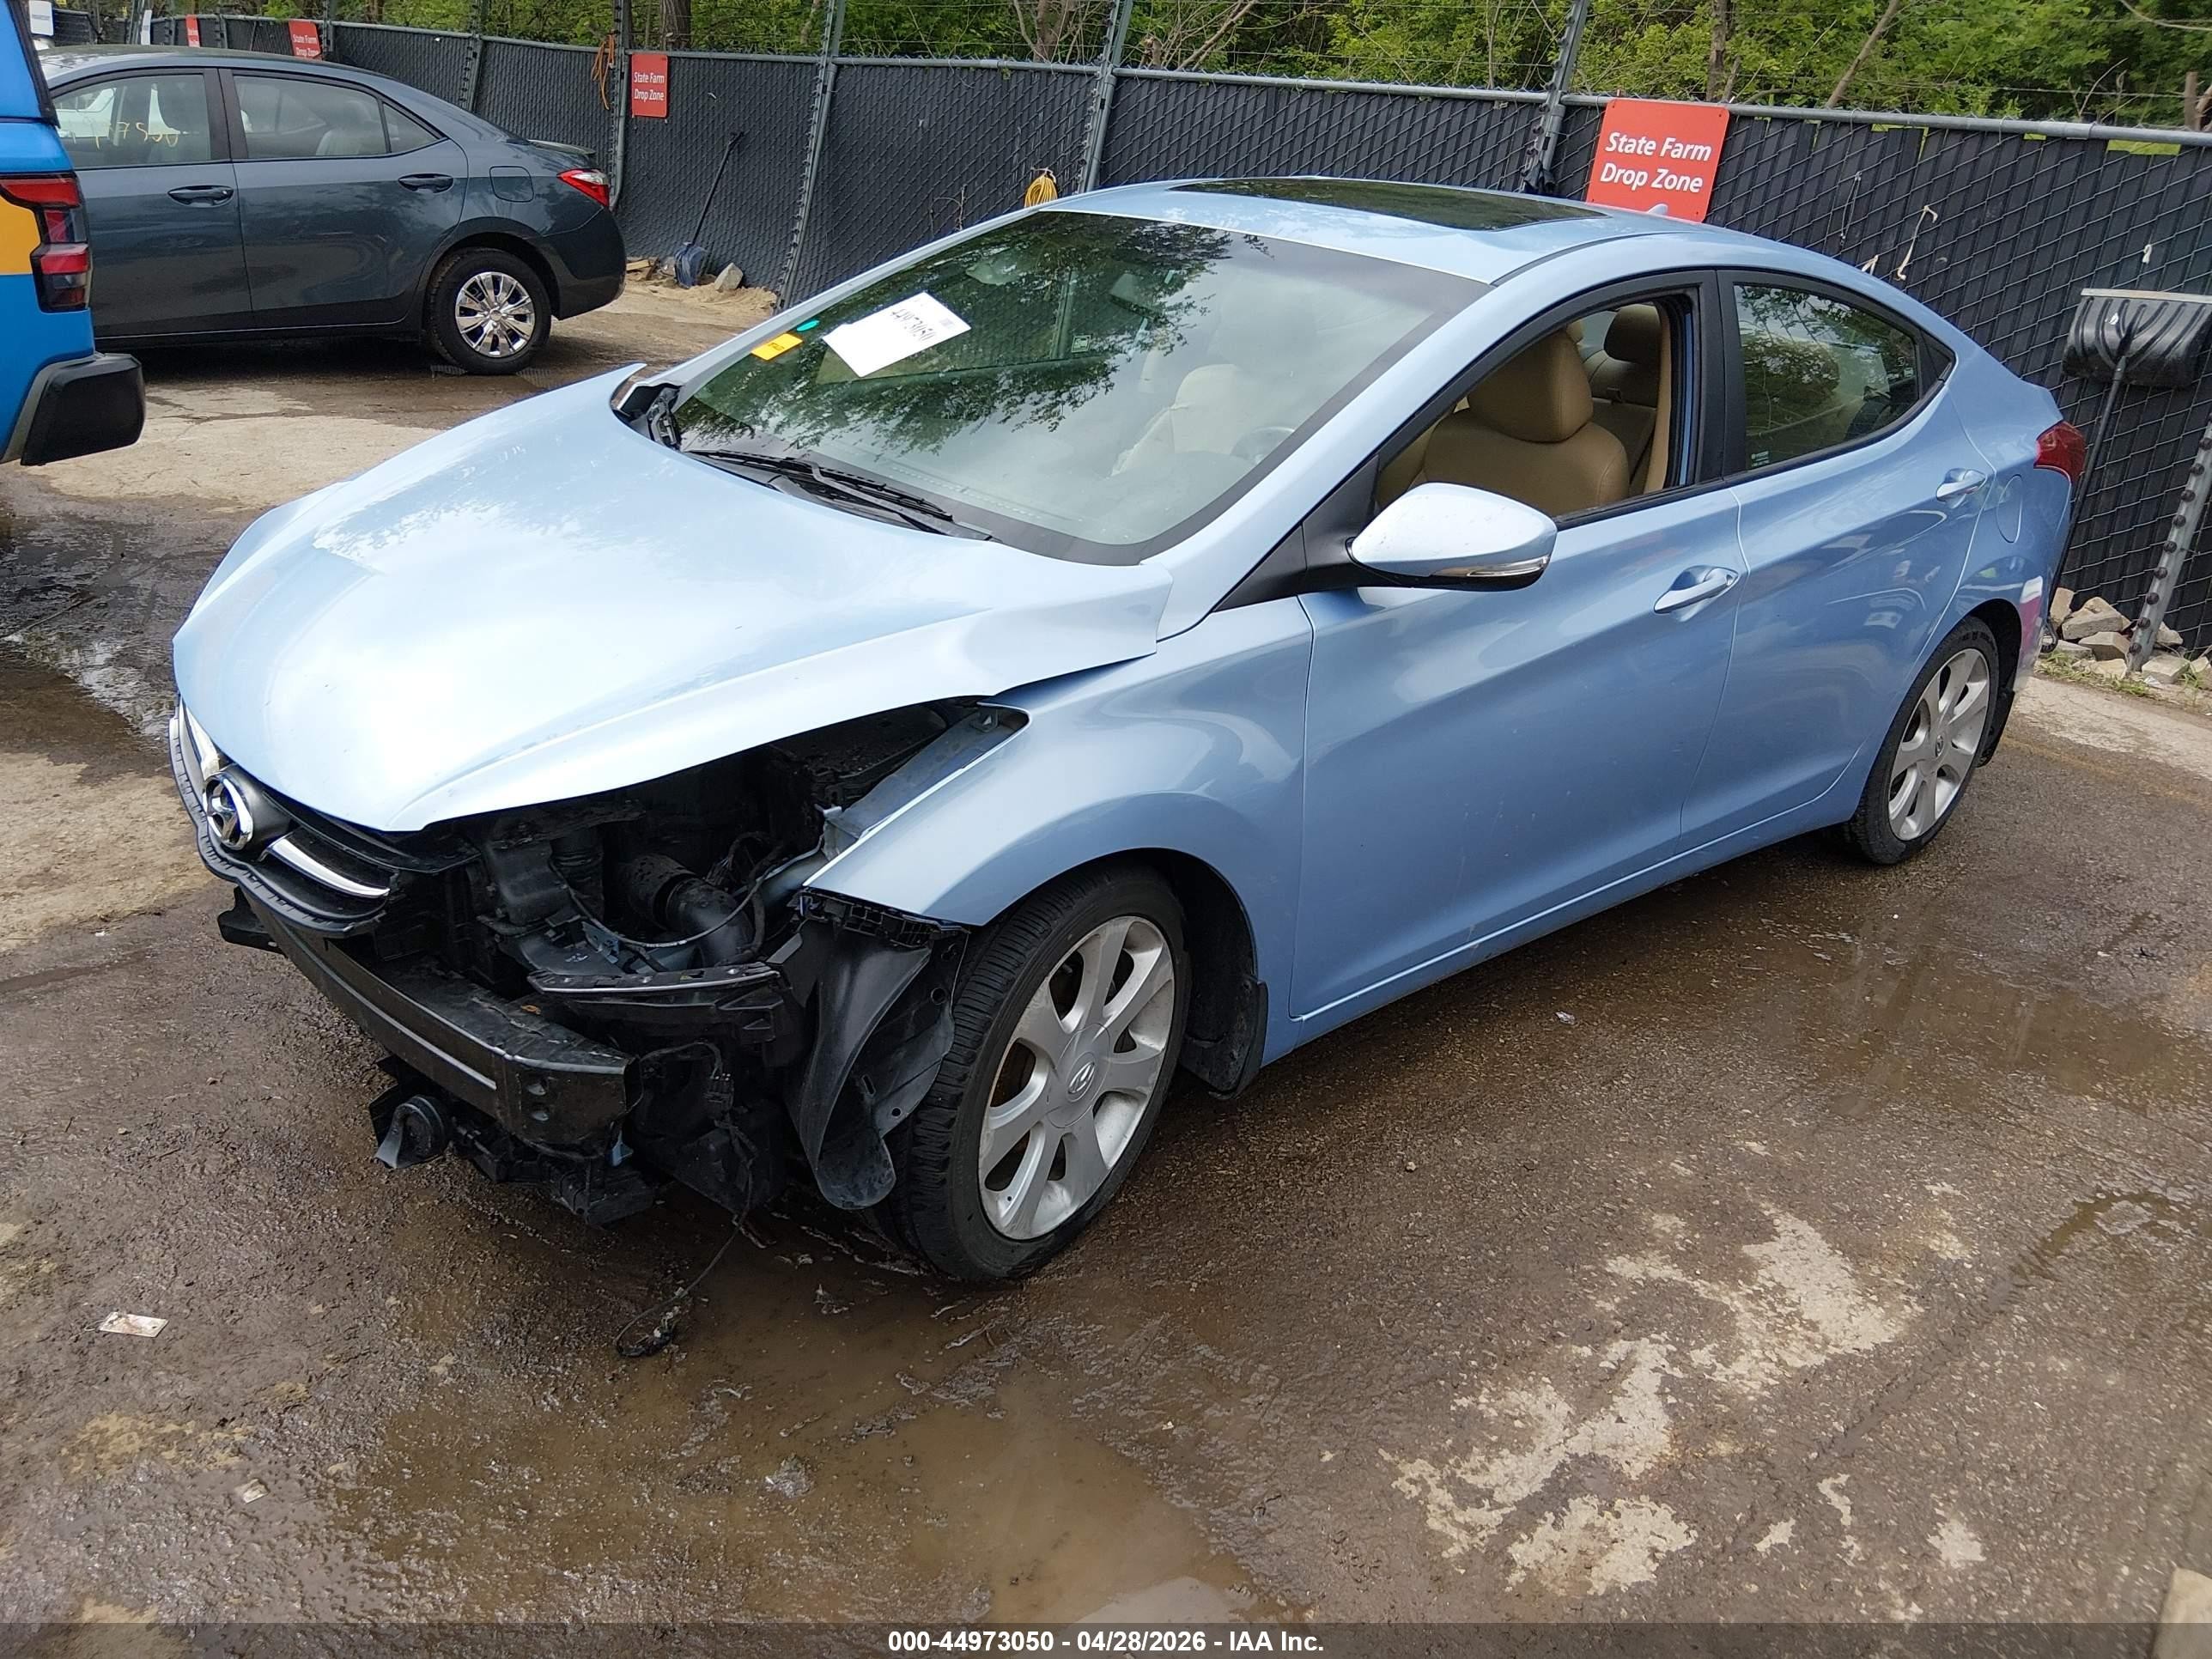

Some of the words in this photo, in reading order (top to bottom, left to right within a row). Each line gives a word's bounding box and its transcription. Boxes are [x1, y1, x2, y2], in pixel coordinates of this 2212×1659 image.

[634, 72, 649, 83] State
[649, 73, 665, 84] Farm
[634, 88, 648, 102] Drop
[648, 89, 665, 101] Zone
[1605, 131, 1656, 156] State
[1659, 137, 1712, 161] Farm
[1600, 162, 1649, 191] Drop
[1650, 168, 1704, 193] Zone
